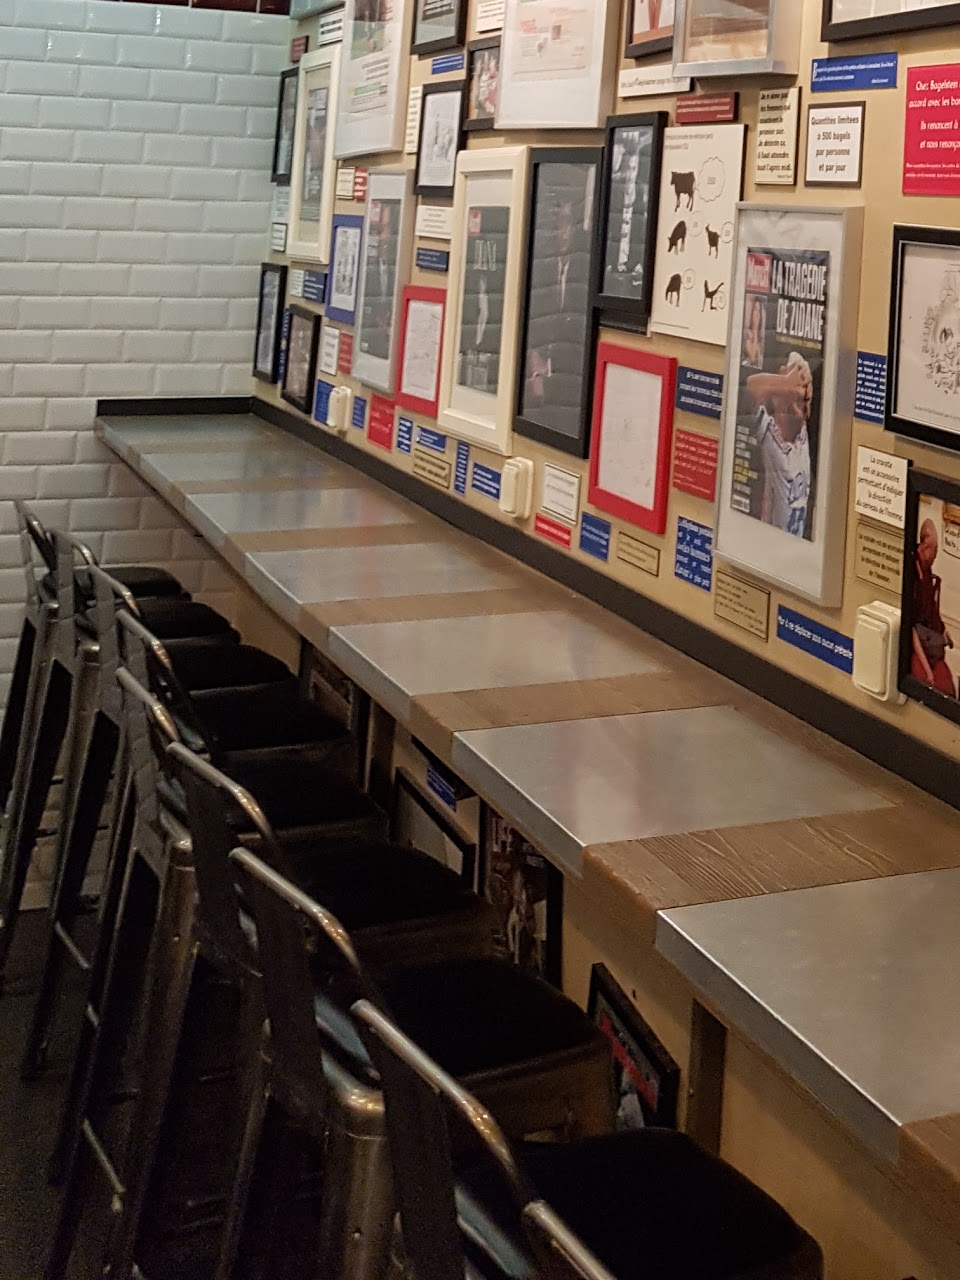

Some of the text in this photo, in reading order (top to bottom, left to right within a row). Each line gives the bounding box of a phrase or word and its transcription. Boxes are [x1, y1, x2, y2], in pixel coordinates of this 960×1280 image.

[771, 260, 784, 294] LA
[776, 299, 825, 340] DE ZIDANE
